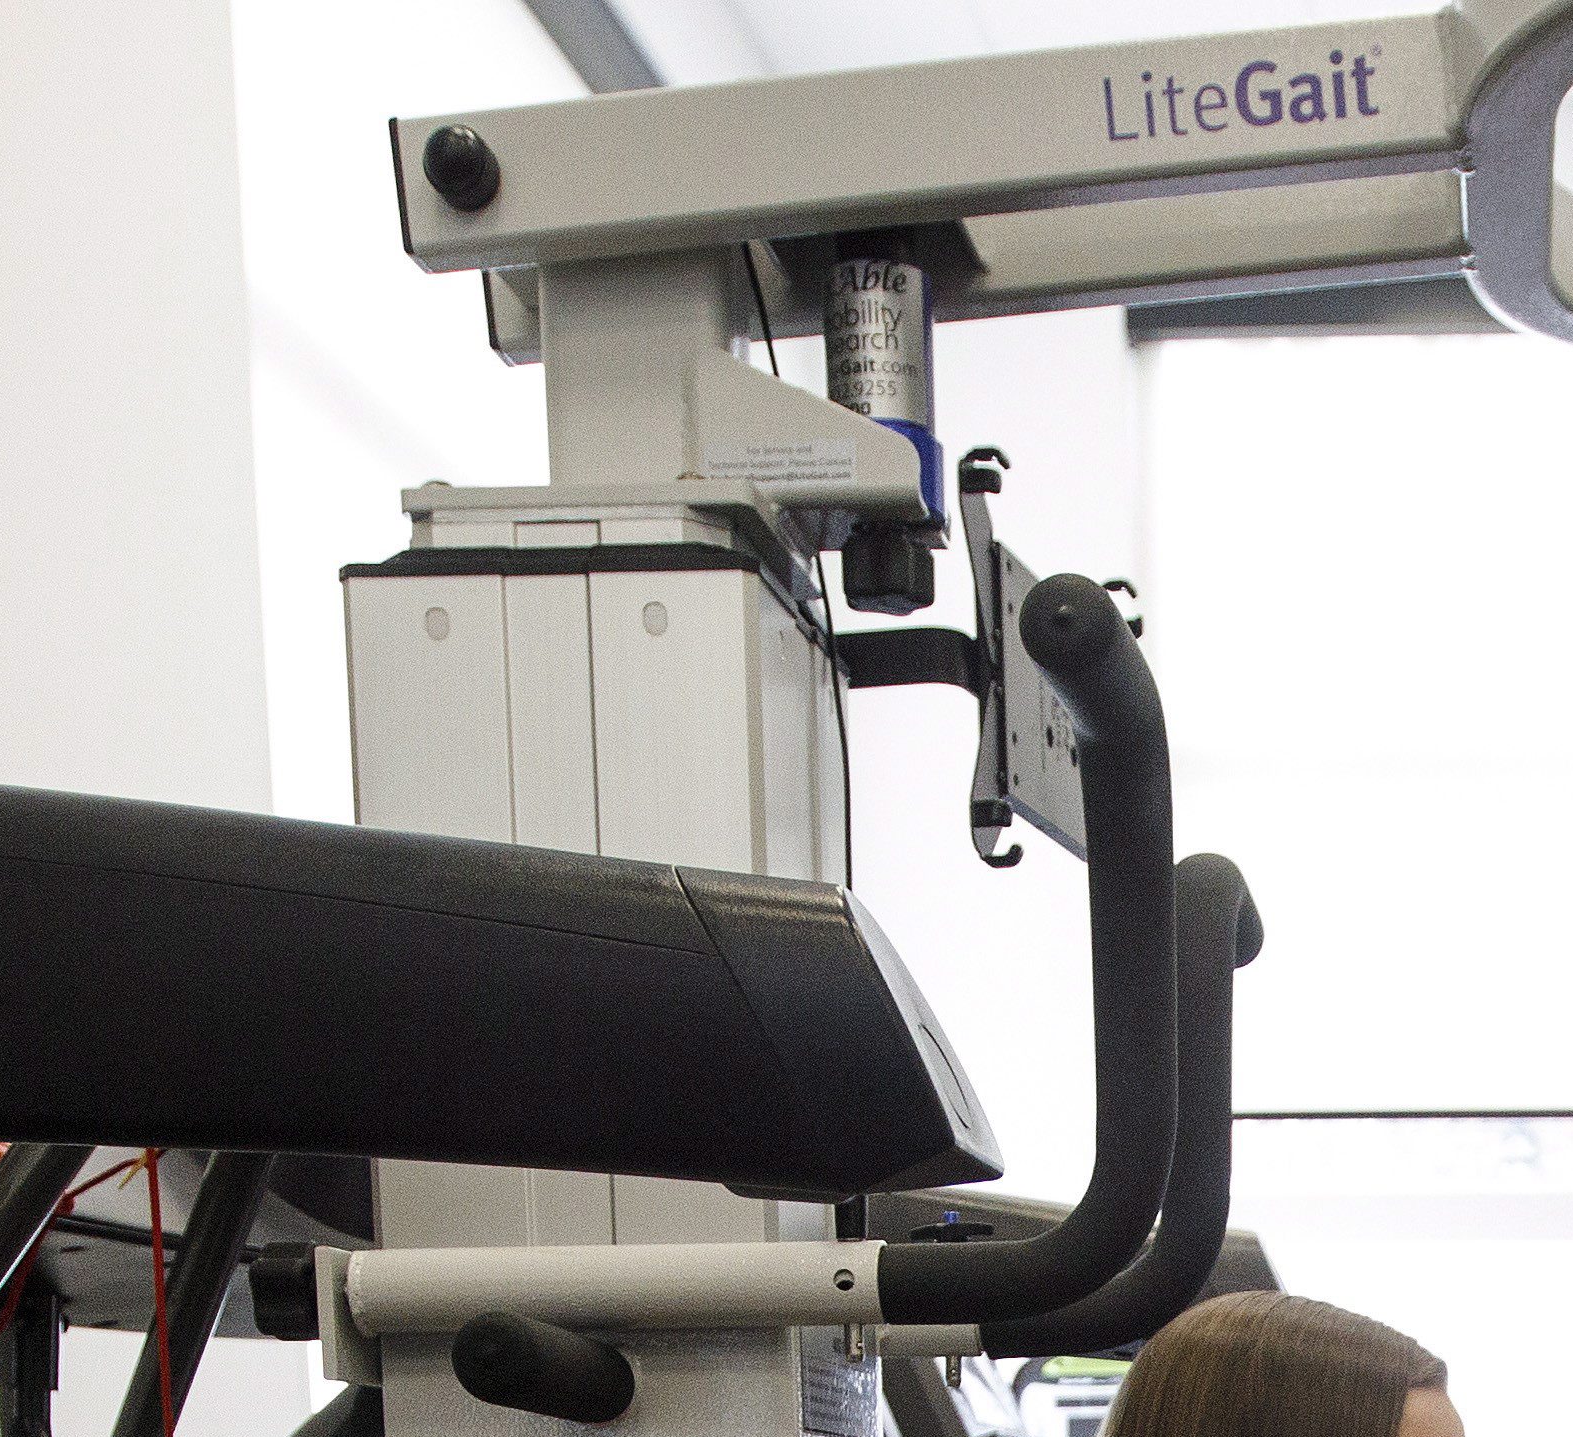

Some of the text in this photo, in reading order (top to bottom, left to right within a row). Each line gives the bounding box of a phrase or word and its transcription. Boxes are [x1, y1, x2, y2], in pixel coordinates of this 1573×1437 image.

[833, 259, 907, 294] Able
[829, 298, 903, 332] obility
[838, 354, 918, 378] Gait.com
